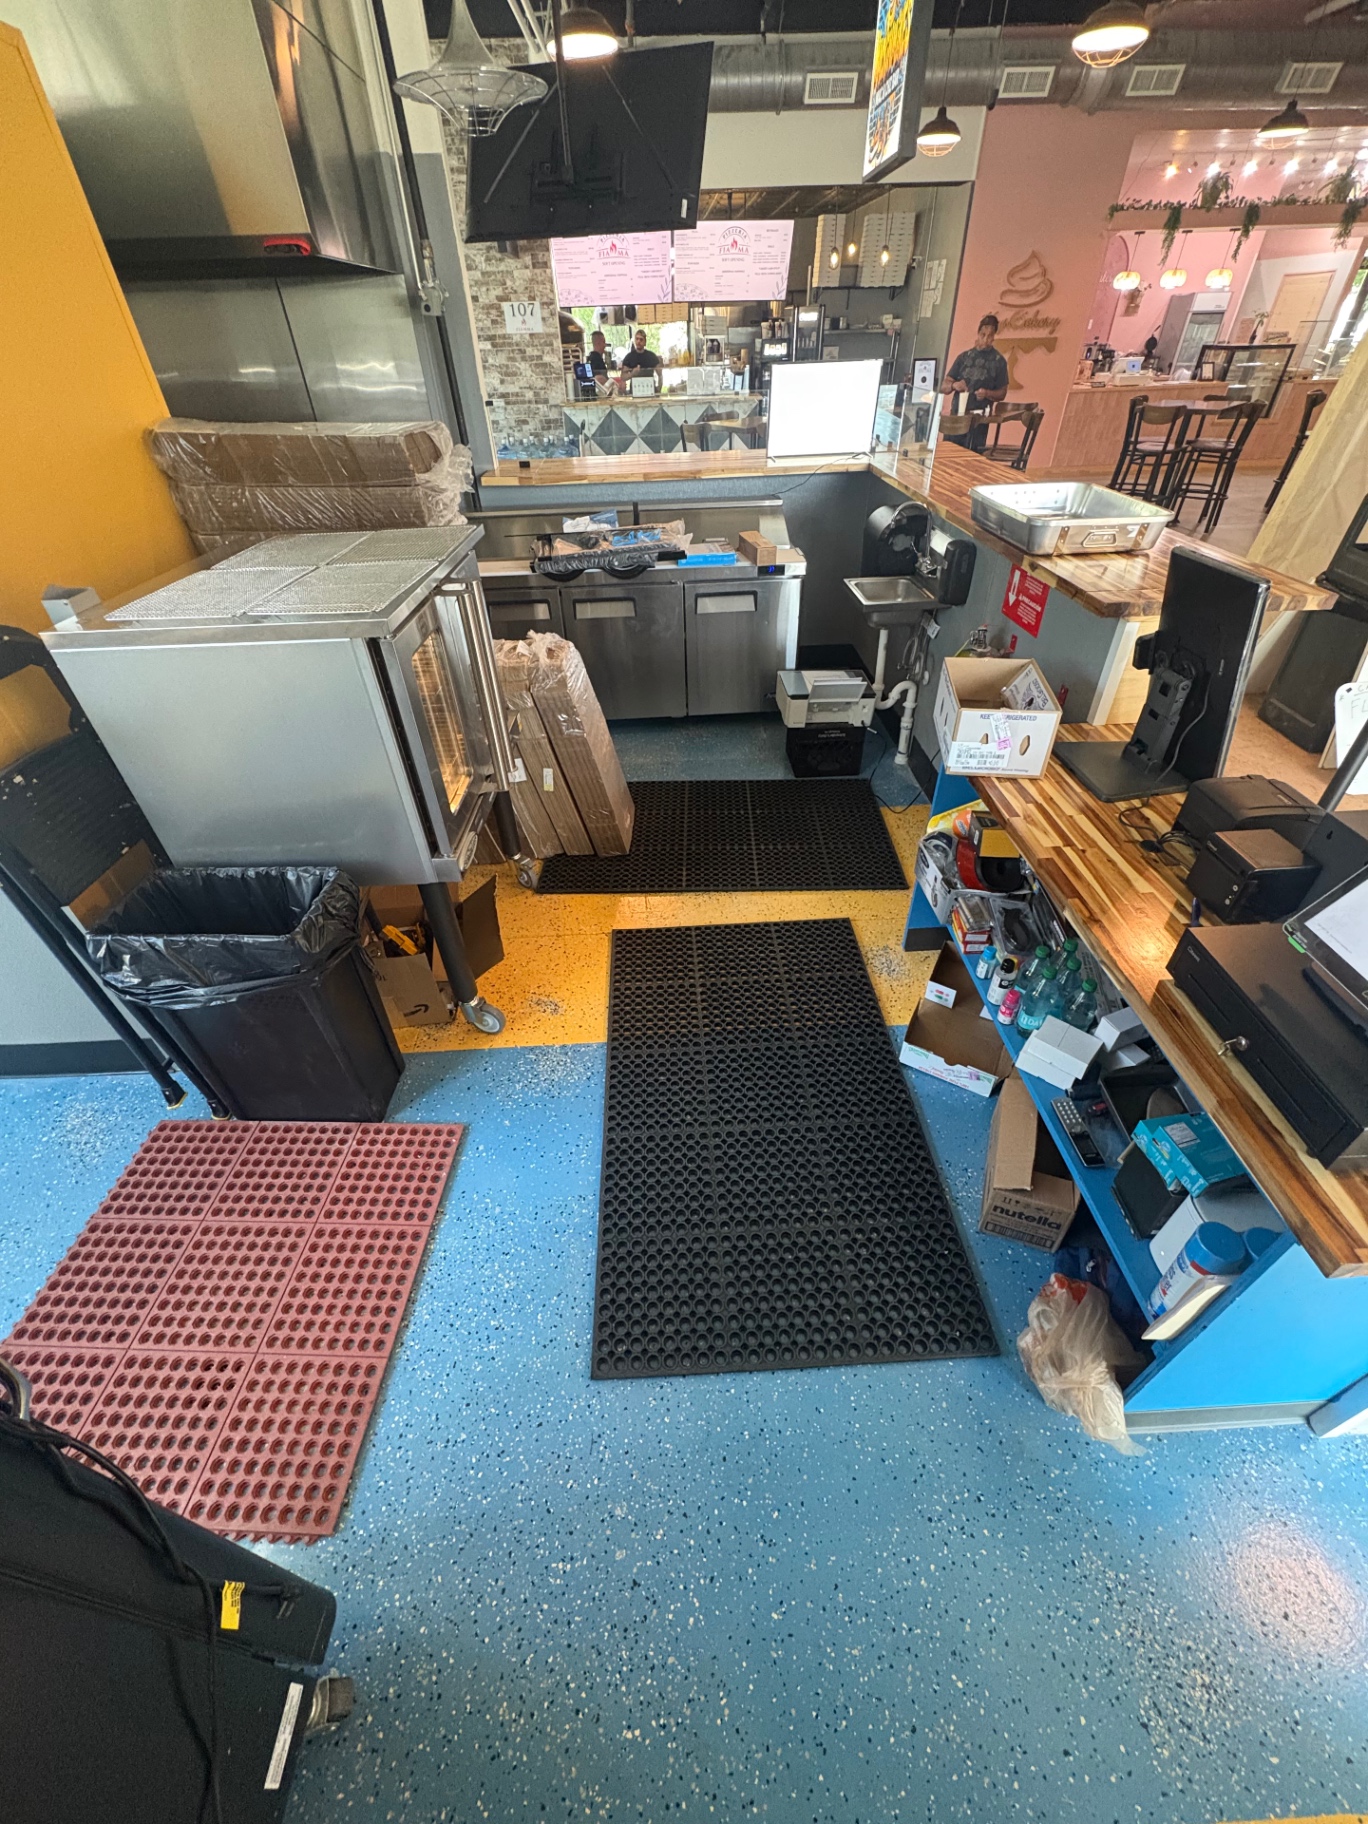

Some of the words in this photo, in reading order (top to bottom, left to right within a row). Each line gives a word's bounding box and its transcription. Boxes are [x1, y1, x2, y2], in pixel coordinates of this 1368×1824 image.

[722, 228, 747, 239] PIZZERIA
[509, 302, 535, 317] 107
[992, 1205, 1062, 1230] nutella
